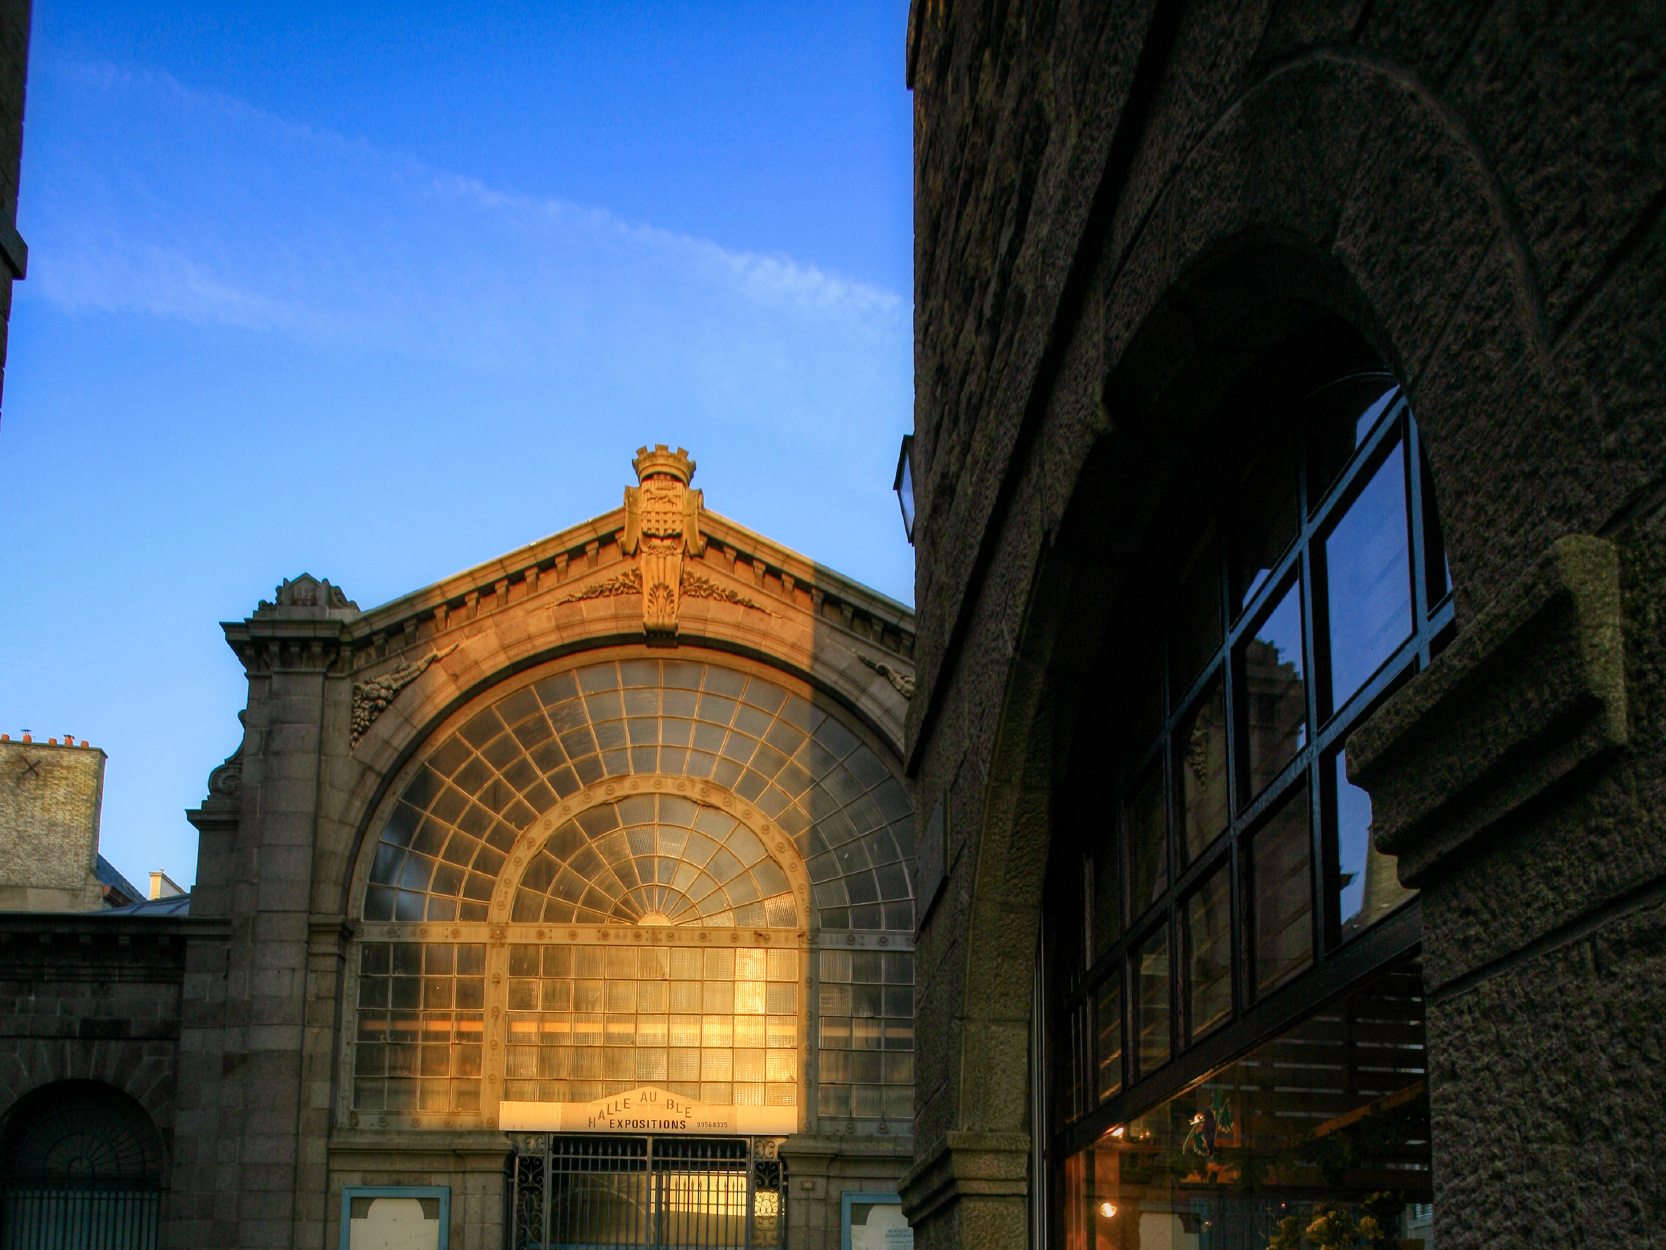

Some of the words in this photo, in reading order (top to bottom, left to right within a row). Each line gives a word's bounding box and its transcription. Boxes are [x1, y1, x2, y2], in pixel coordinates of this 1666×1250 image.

[588, 1097, 631, 1128] HALLE
[640, 1091, 657, 1103] AU
[666, 1098, 692, 1119] BLE
[609, 1118, 687, 1130] EXPOSITIONS
